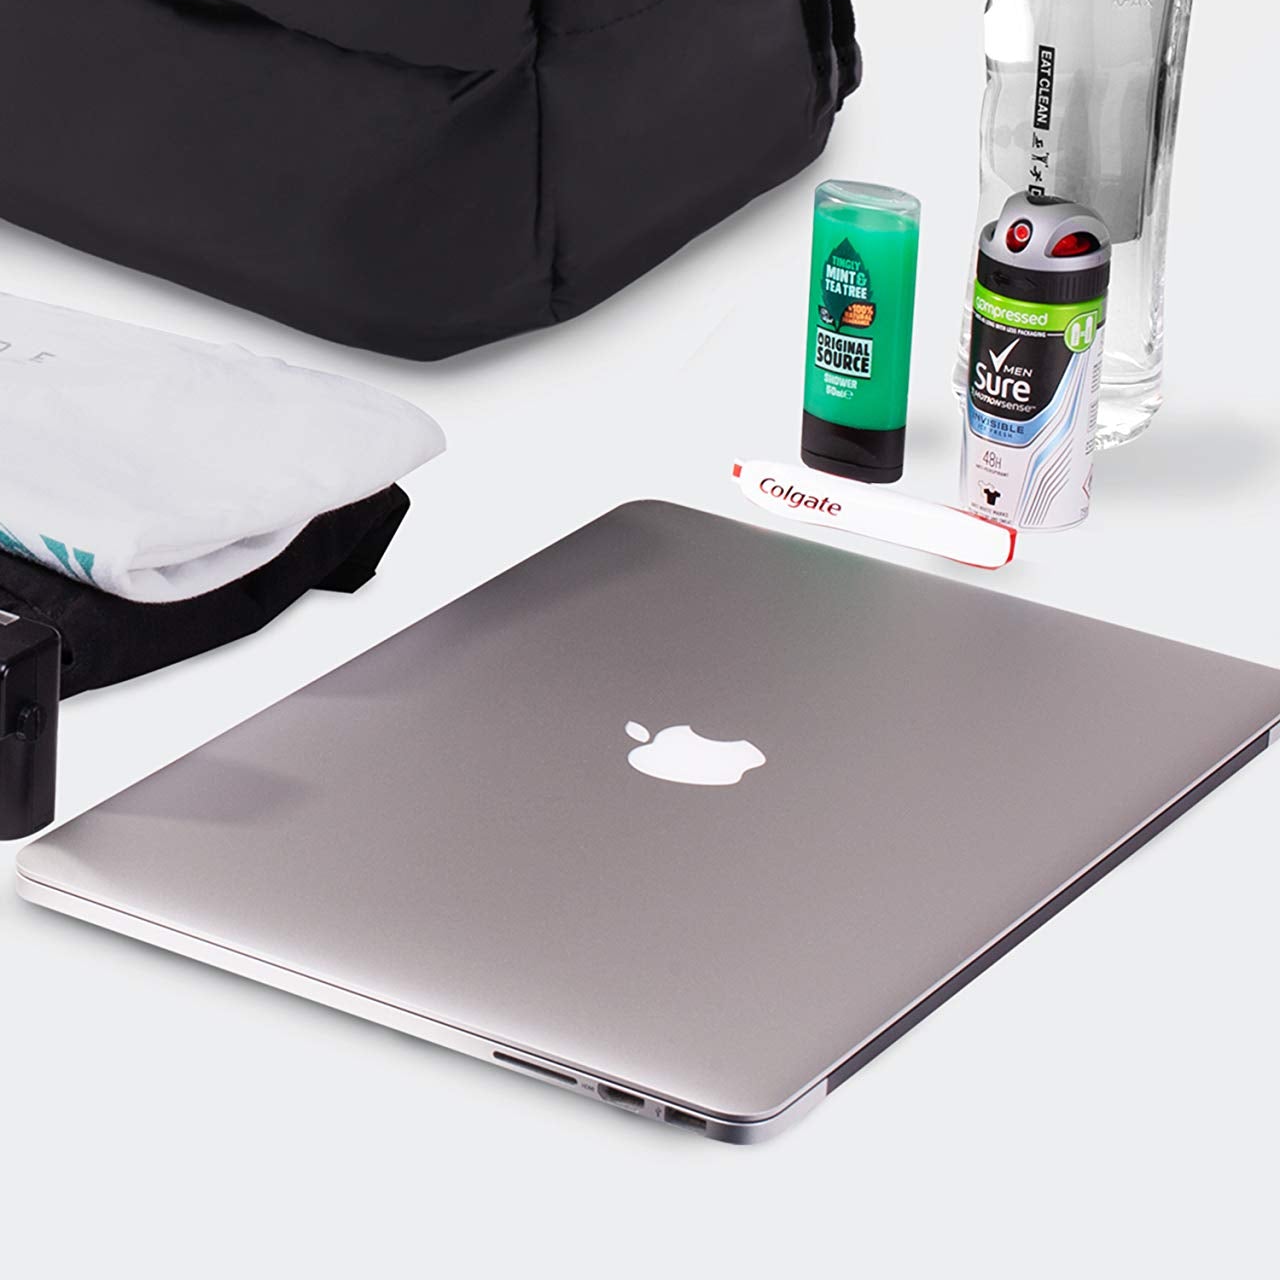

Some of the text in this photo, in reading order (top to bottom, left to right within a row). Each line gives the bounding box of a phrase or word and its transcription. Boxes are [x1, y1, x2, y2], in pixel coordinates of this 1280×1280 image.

[1040, 49, 1053, 77] EAT
[826, 264, 868, 287] MINT &
[832, 255, 861, 271] TINGLY
[825, 278, 868, 300] TEA TREE
[976, 296, 1048, 327] compressed
[818, 332, 870, 357] ORIGINAL
[817, 346, 870, 373] SOURCE
[1003, 365, 1033, 377] MEN
[974, 361, 1031, 402] Sure
[983, 450, 1002, 469] 48H
[759, 477, 842, 516] Colgate
